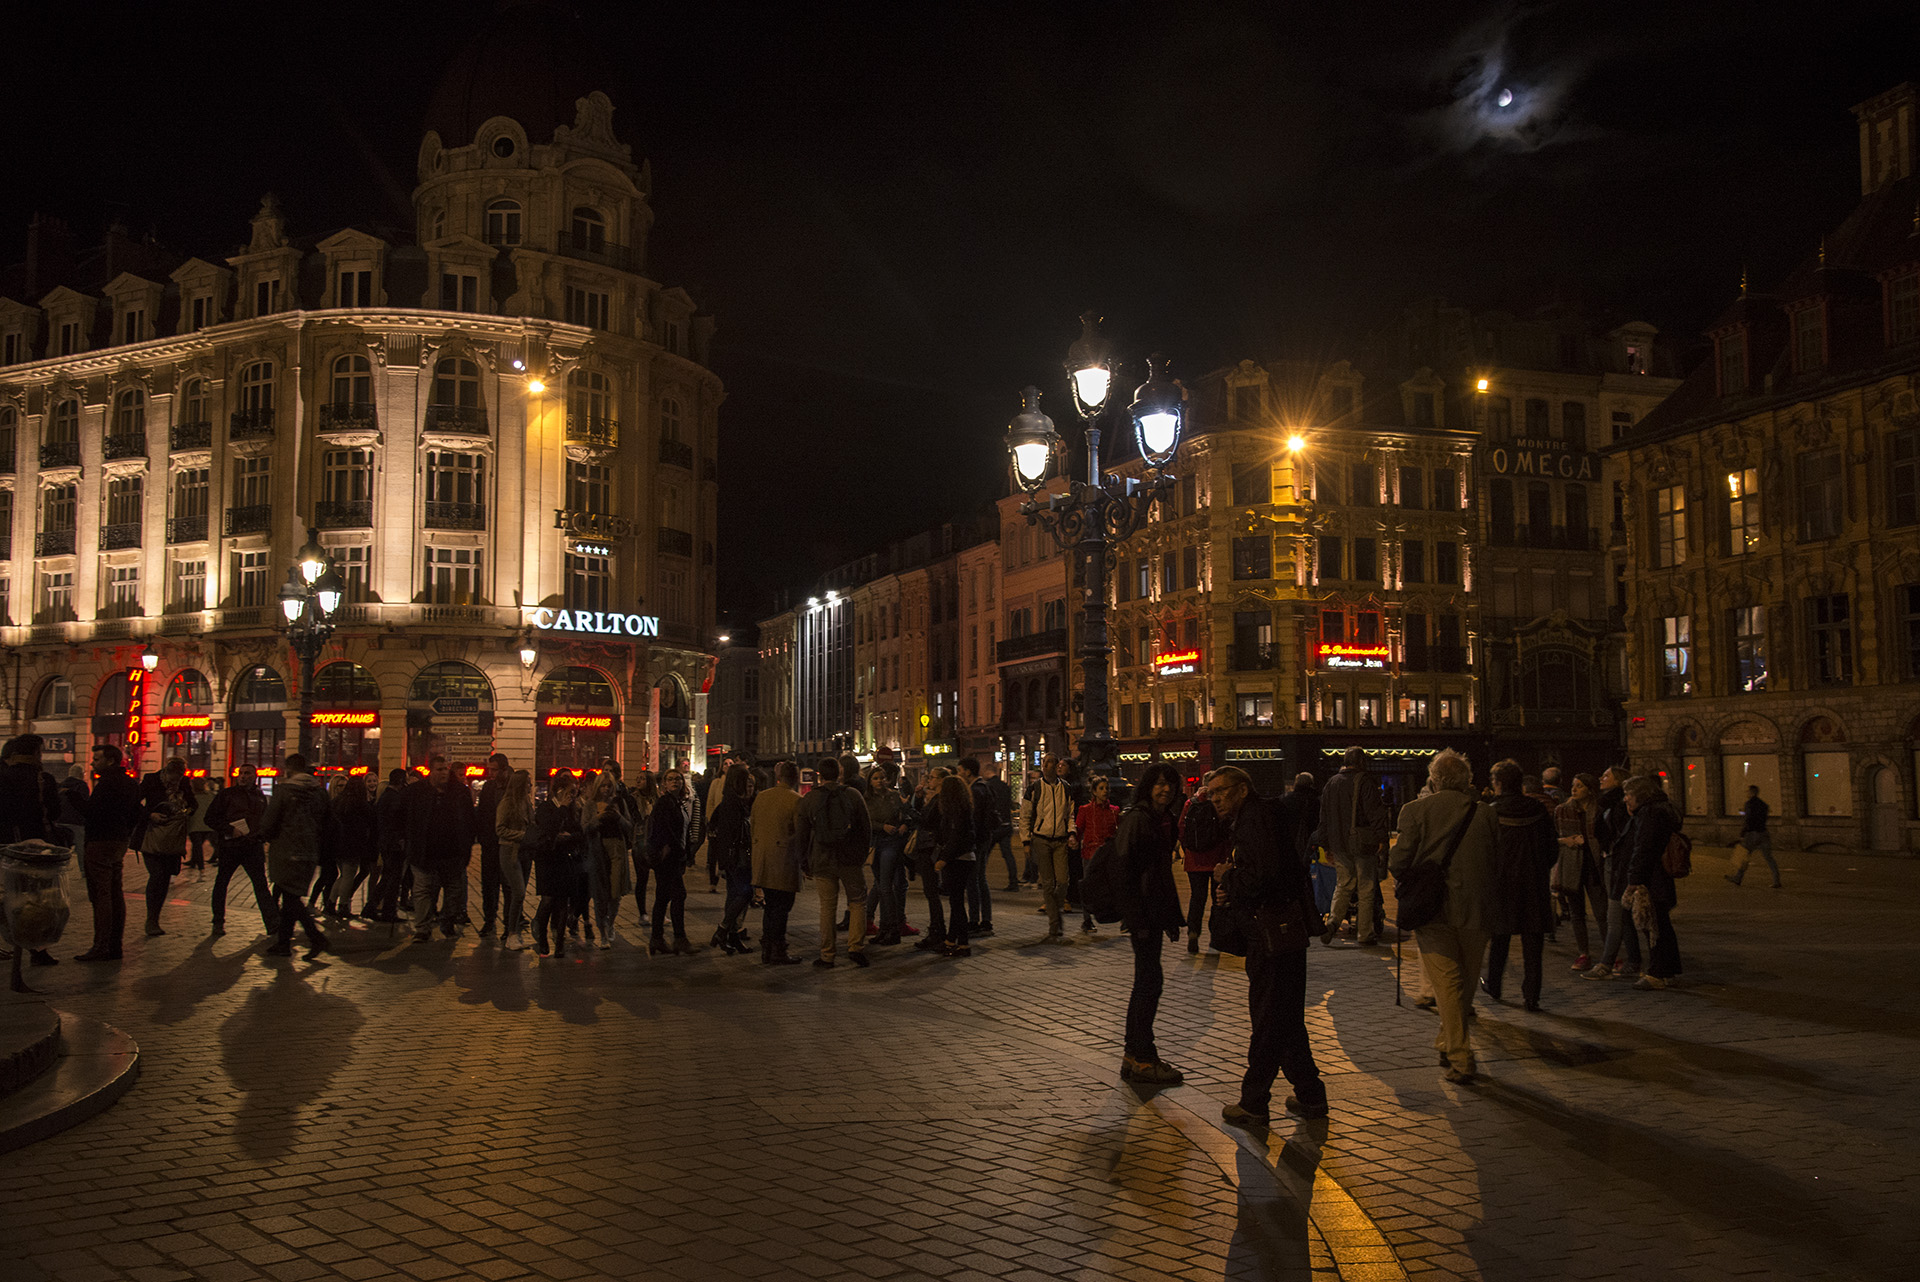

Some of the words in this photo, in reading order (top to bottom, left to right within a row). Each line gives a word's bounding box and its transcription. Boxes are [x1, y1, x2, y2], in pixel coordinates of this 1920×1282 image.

[1517, 438, 1568, 451] MONTRE
[1493, 448, 1592, 479] OMEGA
[553, 509, 642, 538] HOTEL
[532, 608, 660, 638] CARLTON
[1364, 658, 1383, 668] Jean
[128, 669, 143, 745] HIPPO
[1235, 750, 1277, 760] PAUL
